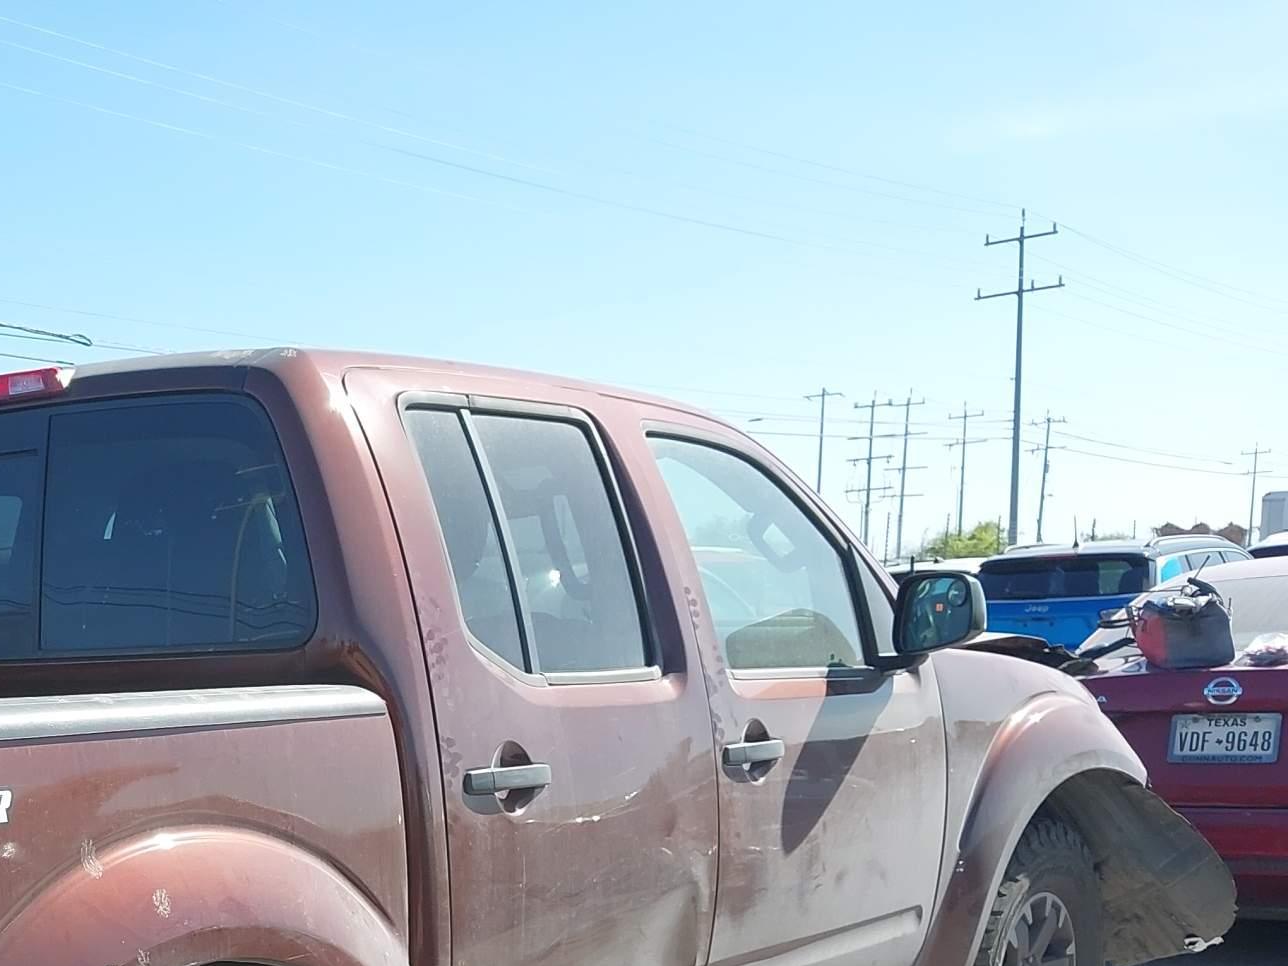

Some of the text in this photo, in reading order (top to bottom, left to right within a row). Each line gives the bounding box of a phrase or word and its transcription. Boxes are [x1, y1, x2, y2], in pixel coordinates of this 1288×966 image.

[1207, 718, 1247, 728] TEXAS
[1178, 730, 1272, 753] VDF 9648
